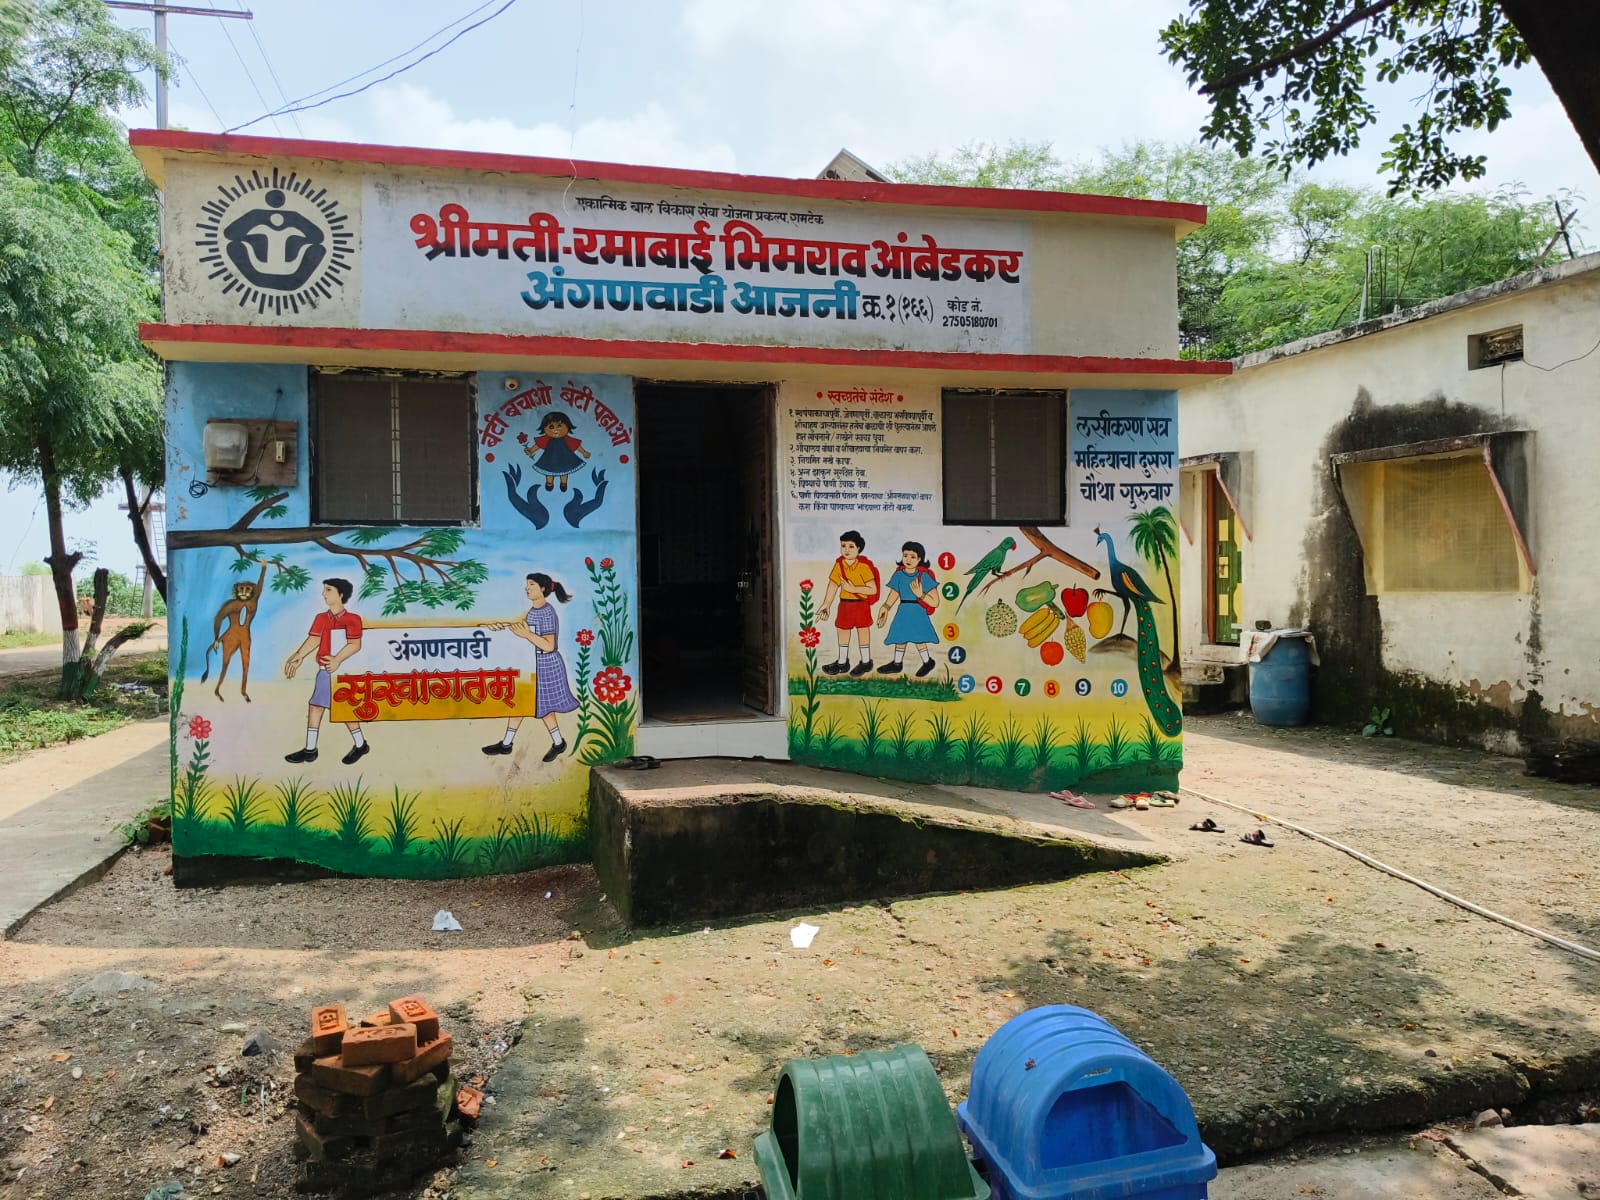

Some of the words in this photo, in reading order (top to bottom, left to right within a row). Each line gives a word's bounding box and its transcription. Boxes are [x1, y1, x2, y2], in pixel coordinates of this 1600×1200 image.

[575, 195, 627, 212] एकात्मिक
[657, 200, 695, 218] विकास
[698, 203, 719, 218] सेवा
[722, 204, 753, 220] योजना
[790, 210, 824, 226] रामटेक
[719, 220, 870, 278] भिमराव
[871, 232, 1024, 284] आंबेडकर
[521, 265, 727, 315] अंगणवाडी
[730, 279, 860, 320] आजनी
[947, 296, 969, 313] कोड
[942, 315, 998, 328] 27505180701
[827, 387, 868, 404] स्वच्छतेचे
[869, 388, 894, 404] संदेश
[477, 412, 509, 447] बेटी
[500, 380, 552, 417] बचाओ
[560, 380, 596, 413] बेटी
[1076, 409, 1146, 439] लसीकरण
[1146, 416, 1172, 441] सत्र
[1139, 451, 1175, 478] दुसरा
[1080, 473, 1116, 502] चौथा
[388, 630, 492, 661] अंगणवाडी
